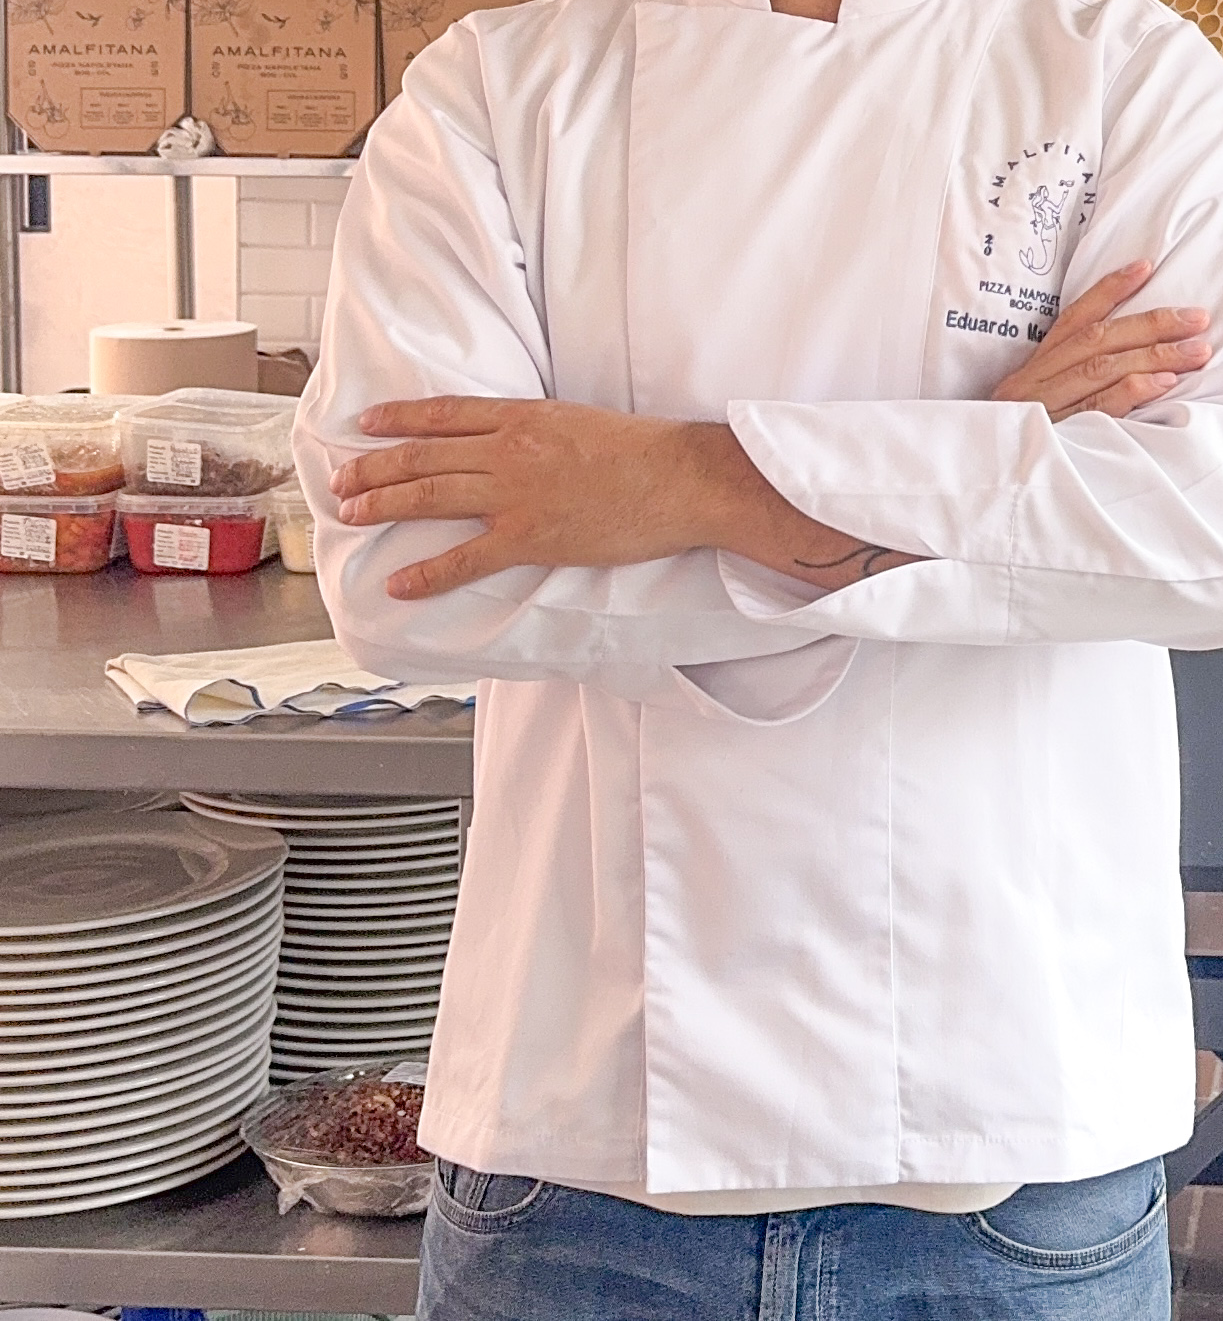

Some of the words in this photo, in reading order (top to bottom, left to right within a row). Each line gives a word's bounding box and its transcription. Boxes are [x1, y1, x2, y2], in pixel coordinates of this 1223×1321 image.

[28, 44, 158, 56] AMALFITANA
[212, 46, 347, 58] AMALFITANA
[988, 141, 1096, 226] AMALFITANA
[979, 280, 1012, 296] PIZZA
[945, 309, 1019, 338] Eduardo
